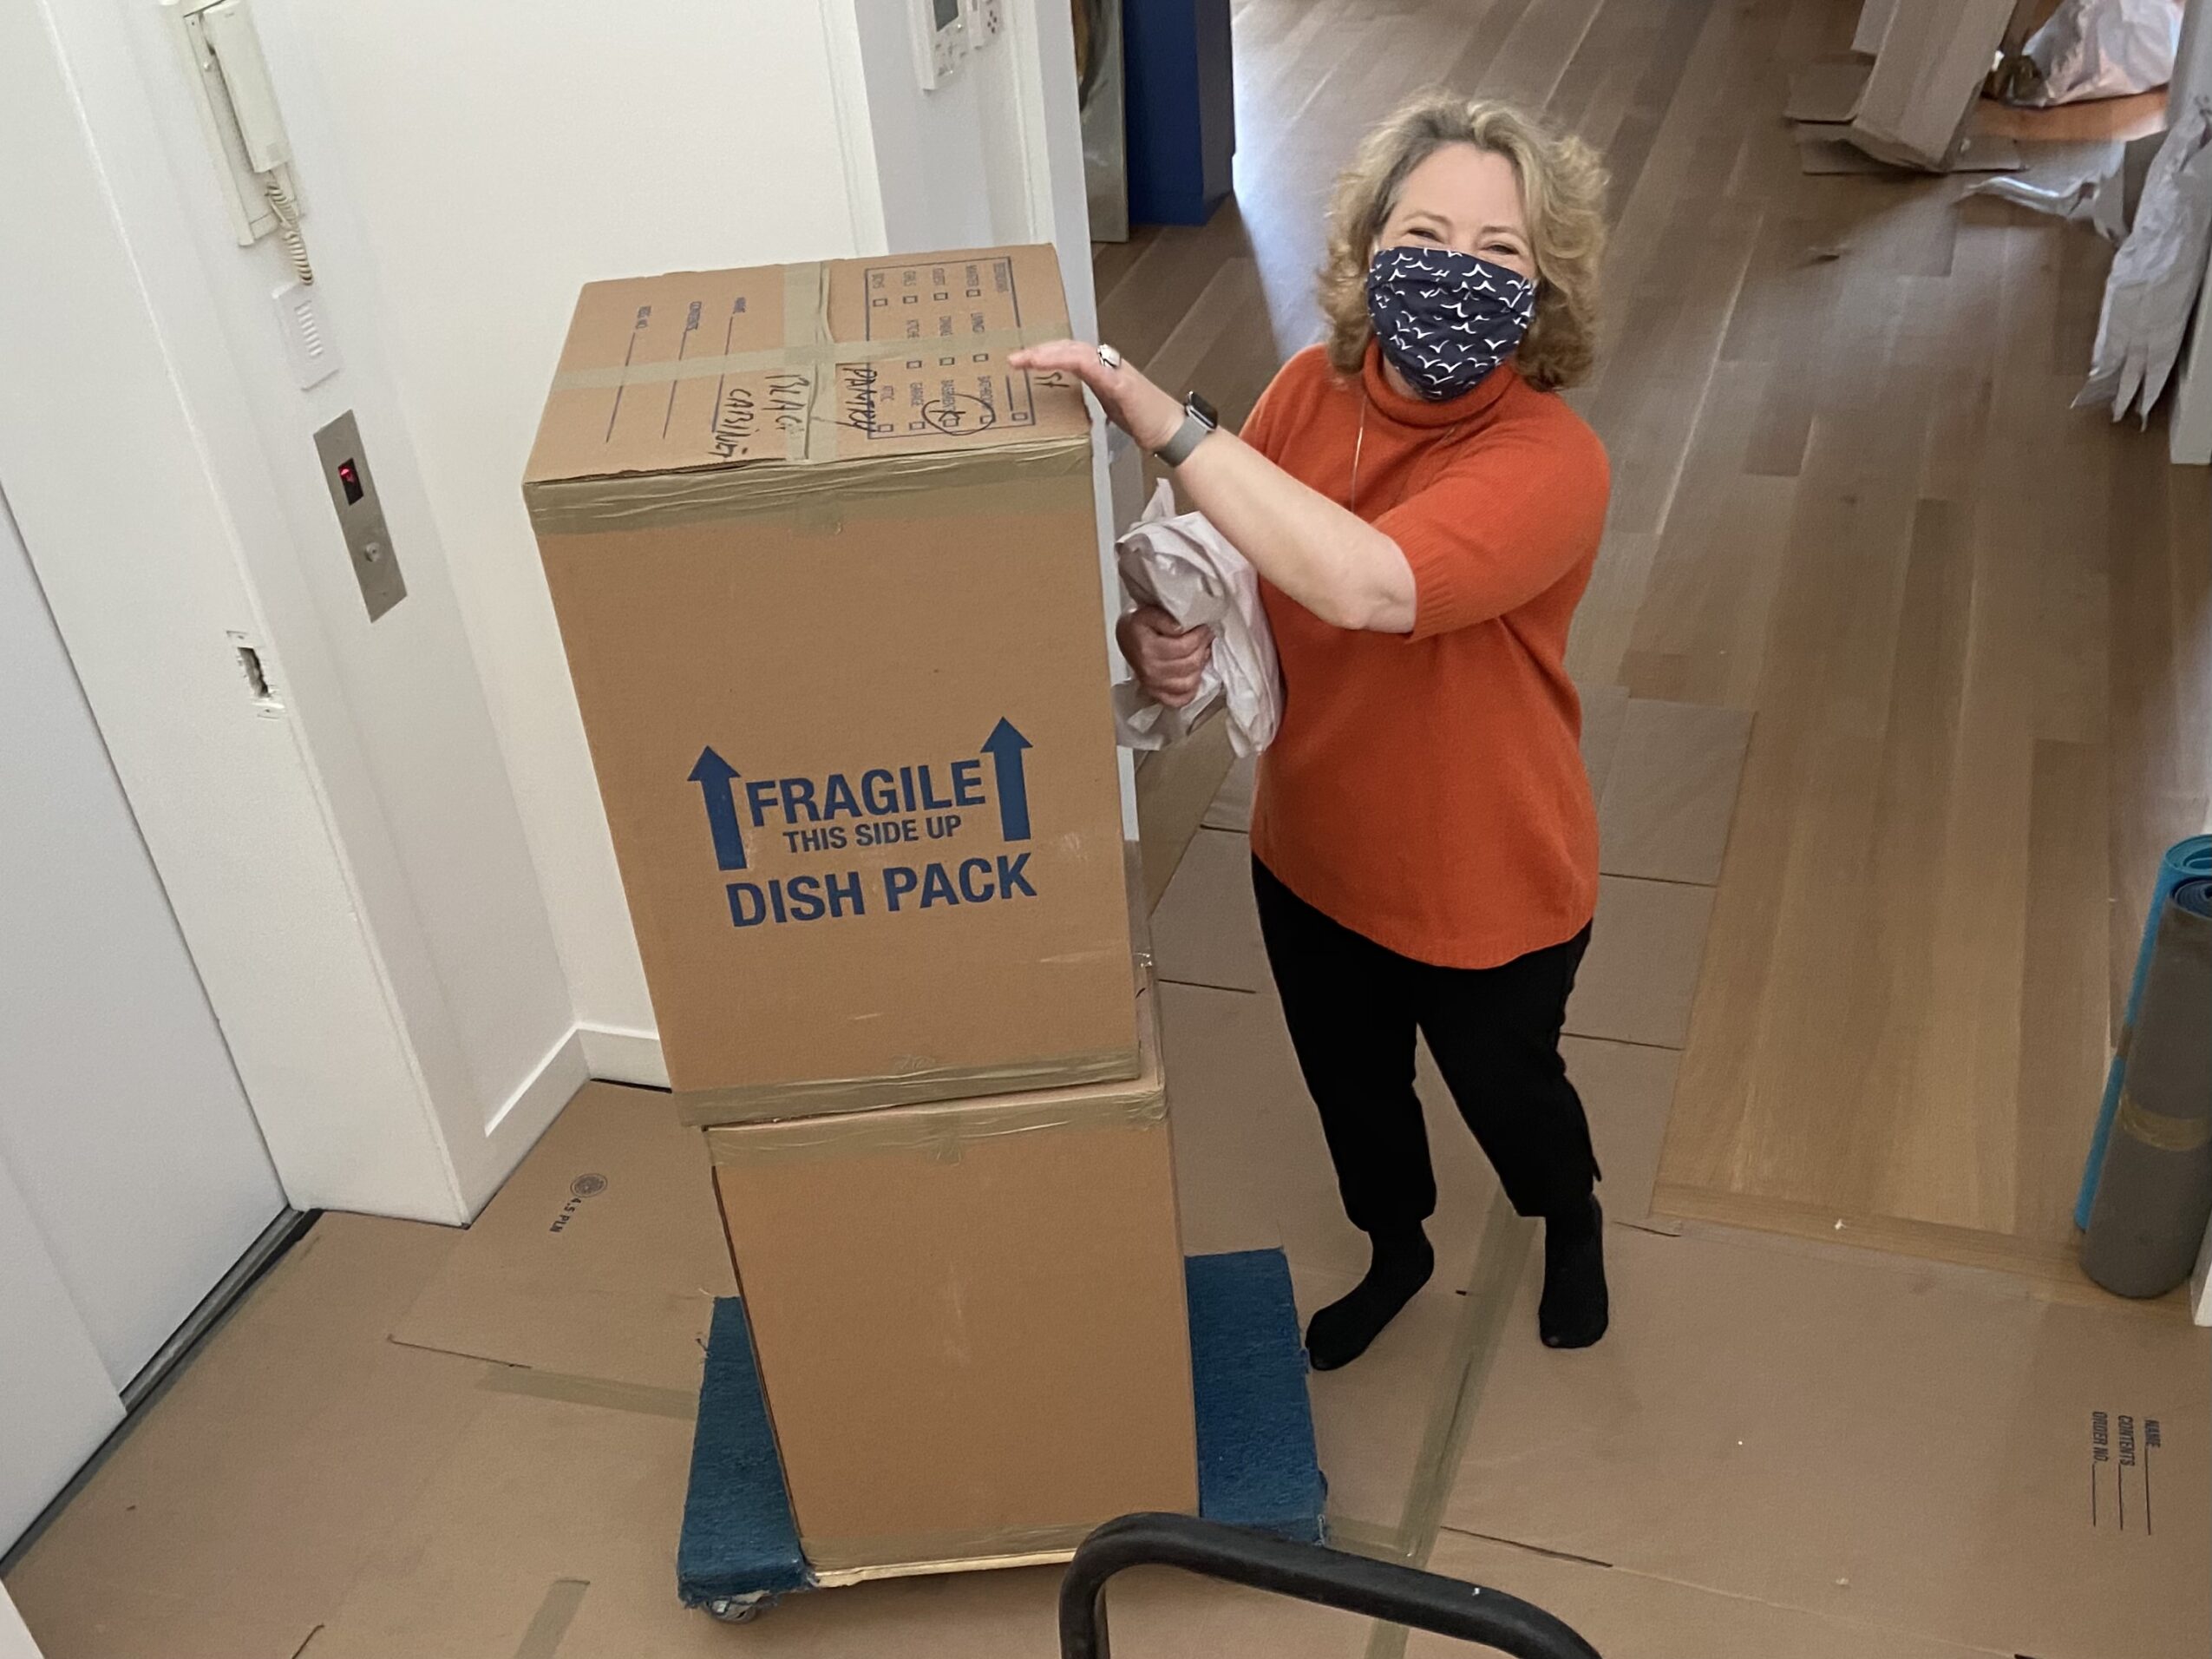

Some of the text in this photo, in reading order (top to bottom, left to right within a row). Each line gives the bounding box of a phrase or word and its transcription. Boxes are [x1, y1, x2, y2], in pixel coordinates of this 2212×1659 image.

[745, 758, 985, 827] FRAGILE
[783, 815, 961, 853] THIS SIDE UP
[725, 852, 1037, 928] DISH PACK
[2091, 1411, 2108, 1446] ORDER
[2117, 1414, 2135, 1466] CONTENTS
